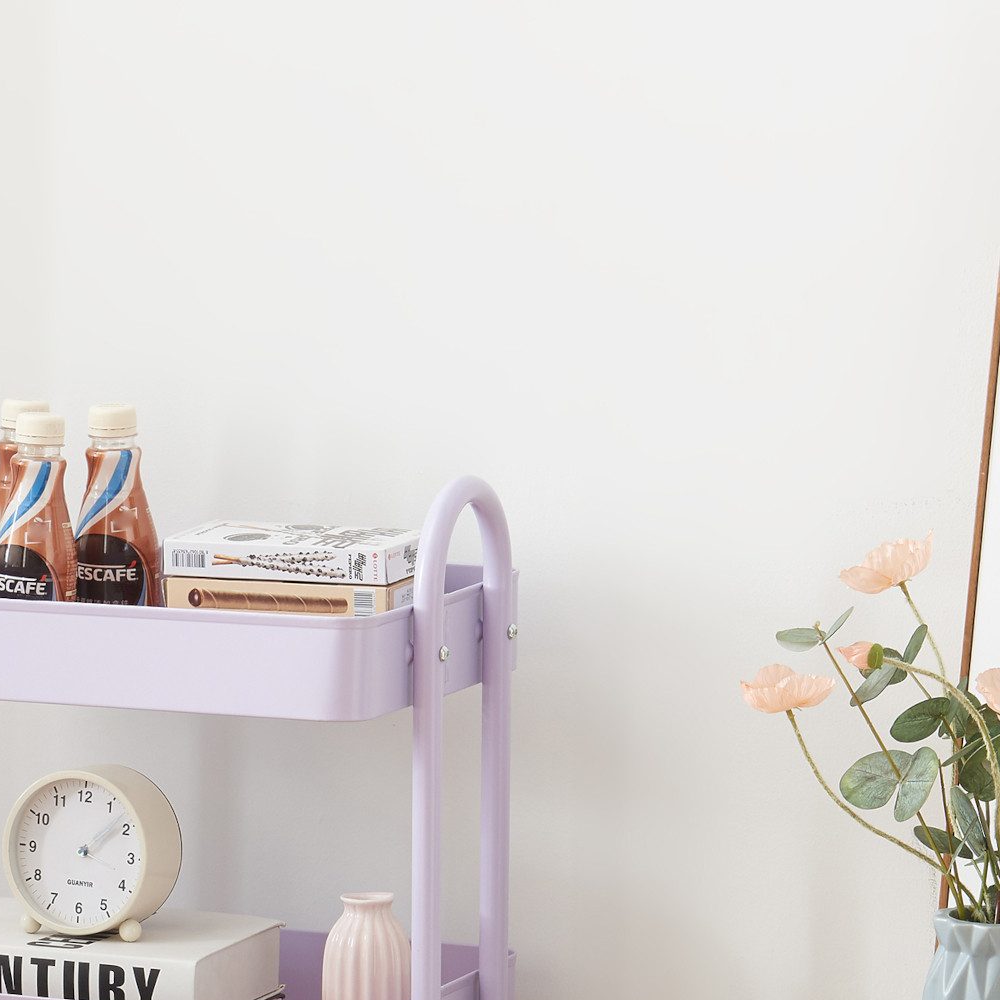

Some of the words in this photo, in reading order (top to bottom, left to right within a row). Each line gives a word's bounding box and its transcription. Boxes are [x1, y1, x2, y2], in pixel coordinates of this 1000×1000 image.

[76, 561, 138, 582] ESCAFÉ
[53, 794, 66, 807] 11
[78, 790, 93, 803] 12
[107, 801, 112, 813] 1
[36, 812, 50, 825] 10
[122, 823, 130, 836] 2
[29, 840, 37, 852] 9
[127, 852, 135, 865] 3
[34, 868, 42, 881] 8
[118, 879, 126, 891] 4
[50, 892, 58, 904] 7
[75, 902, 83, 914] 6
[100, 899, 108, 911] 5
